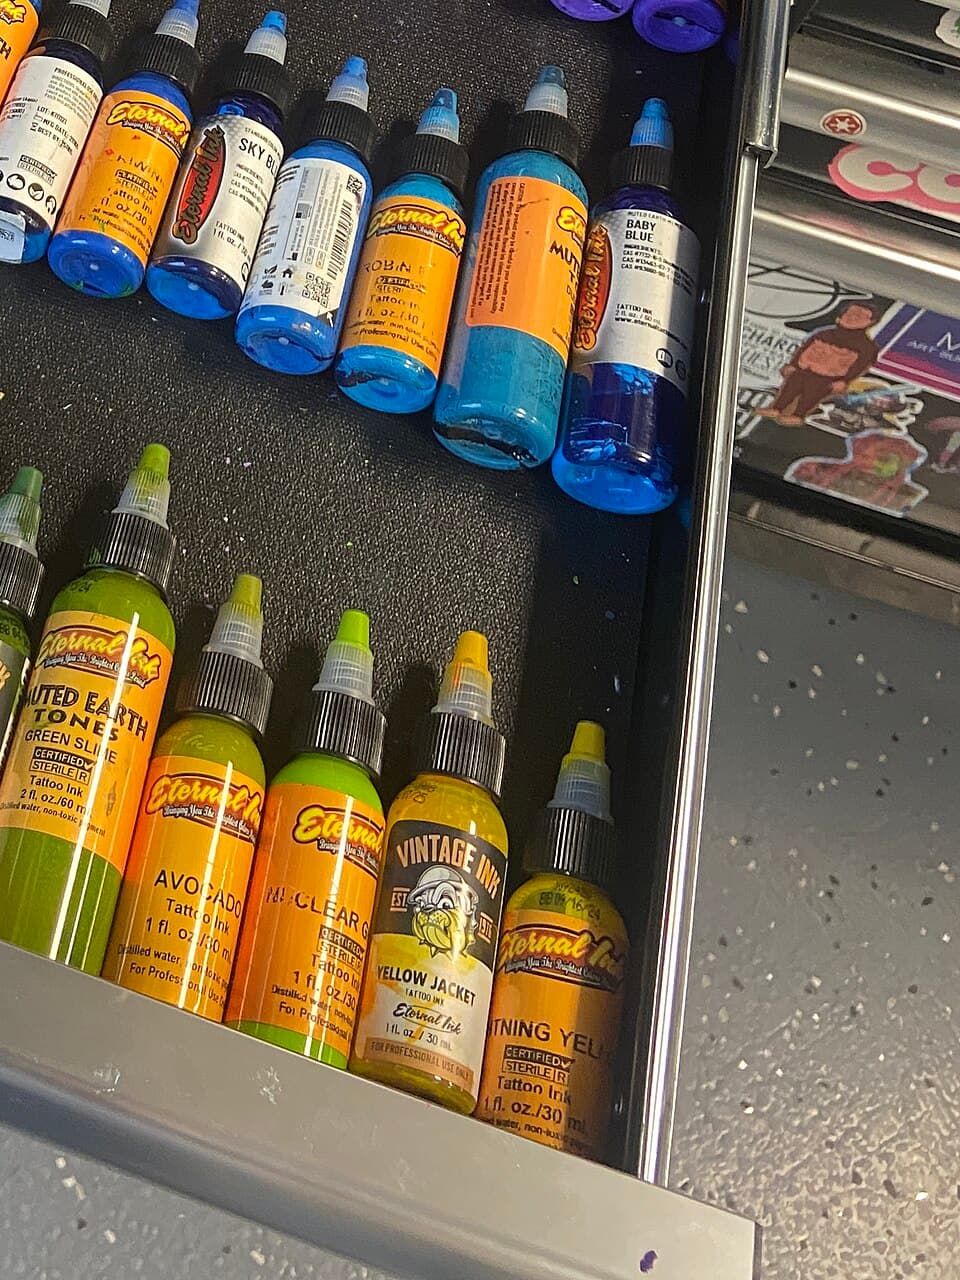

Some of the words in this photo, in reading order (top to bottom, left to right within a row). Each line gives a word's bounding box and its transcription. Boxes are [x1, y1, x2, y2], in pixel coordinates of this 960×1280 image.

[239, 136, 265, 163] SKY
[625, 229, 655, 243] BLUE
[626, 218, 657, 232] BABY
[38, 629, 127, 662] Eternal
[32, 708, 119, 744] TONES
[85, 692, 149, 741] EARTH
[24, 728, 71, 749] GREEN
[73, 737, 119, 766] SLIME
[33, 747, 86, 768] CERTIFIED
[31, 759, 75, 779] STERILE
[29, 774, 65, 793] Tattoo
[65, 785, 85, 799] Ink
[146, 775, 248, 815] Eternal
[396, 832, 478, 874] VINTAGE
[479, 856, 502, 901] INK
[154, 869, 243, 919] AVOCADO
[165, 897, 211, 926] Tattoo
[213, 913, 231, 937] Ink
[129, 961, 147, 977] For
[311, 953, 351, 983] Tattoo
[376, 963, 429, 988] YELLOW
[429, 968, 477, 1008] JACKET
[404, 987, 431, 1004] TATTOO
[392, 1002, 443, 1027] Eternal
[442, 1017, 464, 1037] Ink
[504, 1060, 551, 1081] STERILE
[505, 1045, 561, 1067] CERTIFIED
[496, 1075, 544, 1097] Tattoo
[547, 1082, 573, 1105] Ink
